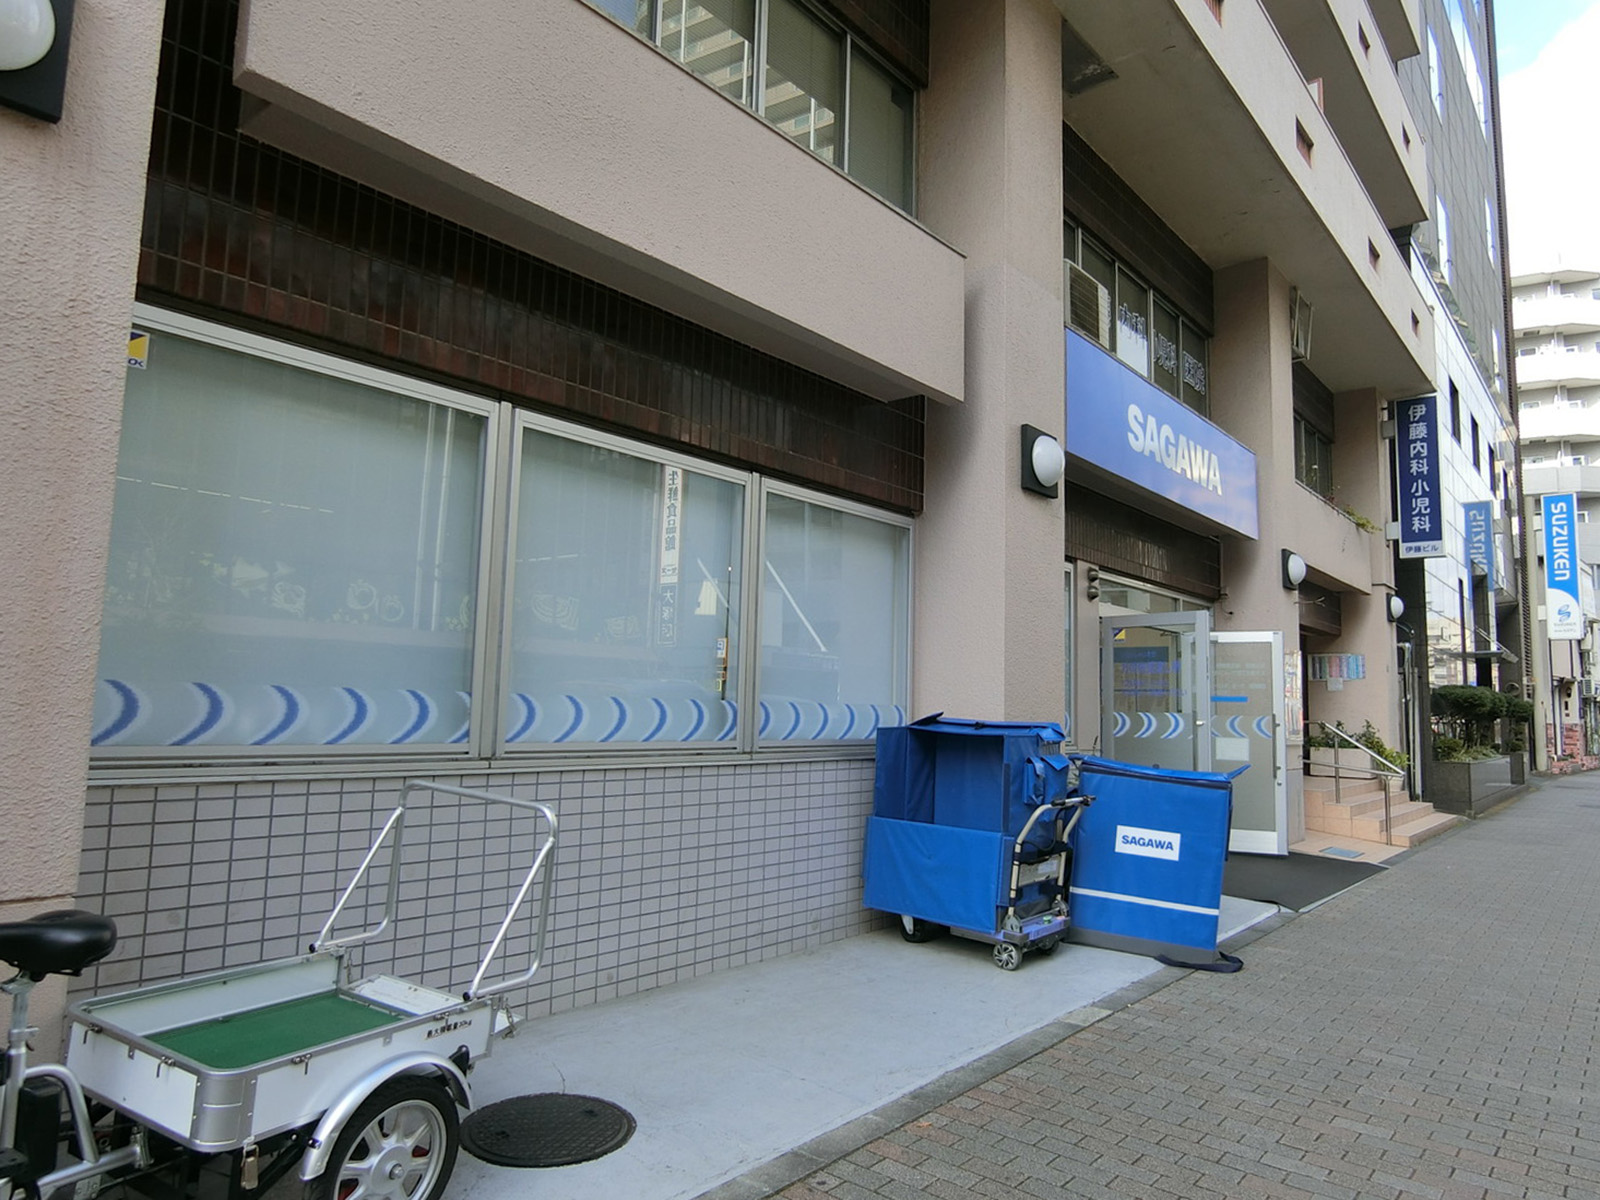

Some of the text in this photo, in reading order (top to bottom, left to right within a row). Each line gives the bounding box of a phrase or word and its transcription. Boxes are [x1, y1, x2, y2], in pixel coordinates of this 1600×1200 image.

[1127, 403, 1222, 496] SAGAWA
[1407, 403, 1432, 533] 伊藤内科小児科
[1405, 544, 1439, 553] 伊藤ビル
[1550, 501, 1571, 582] SUZUKEN
[1121, 834, 1174, 851] SAGAWA
